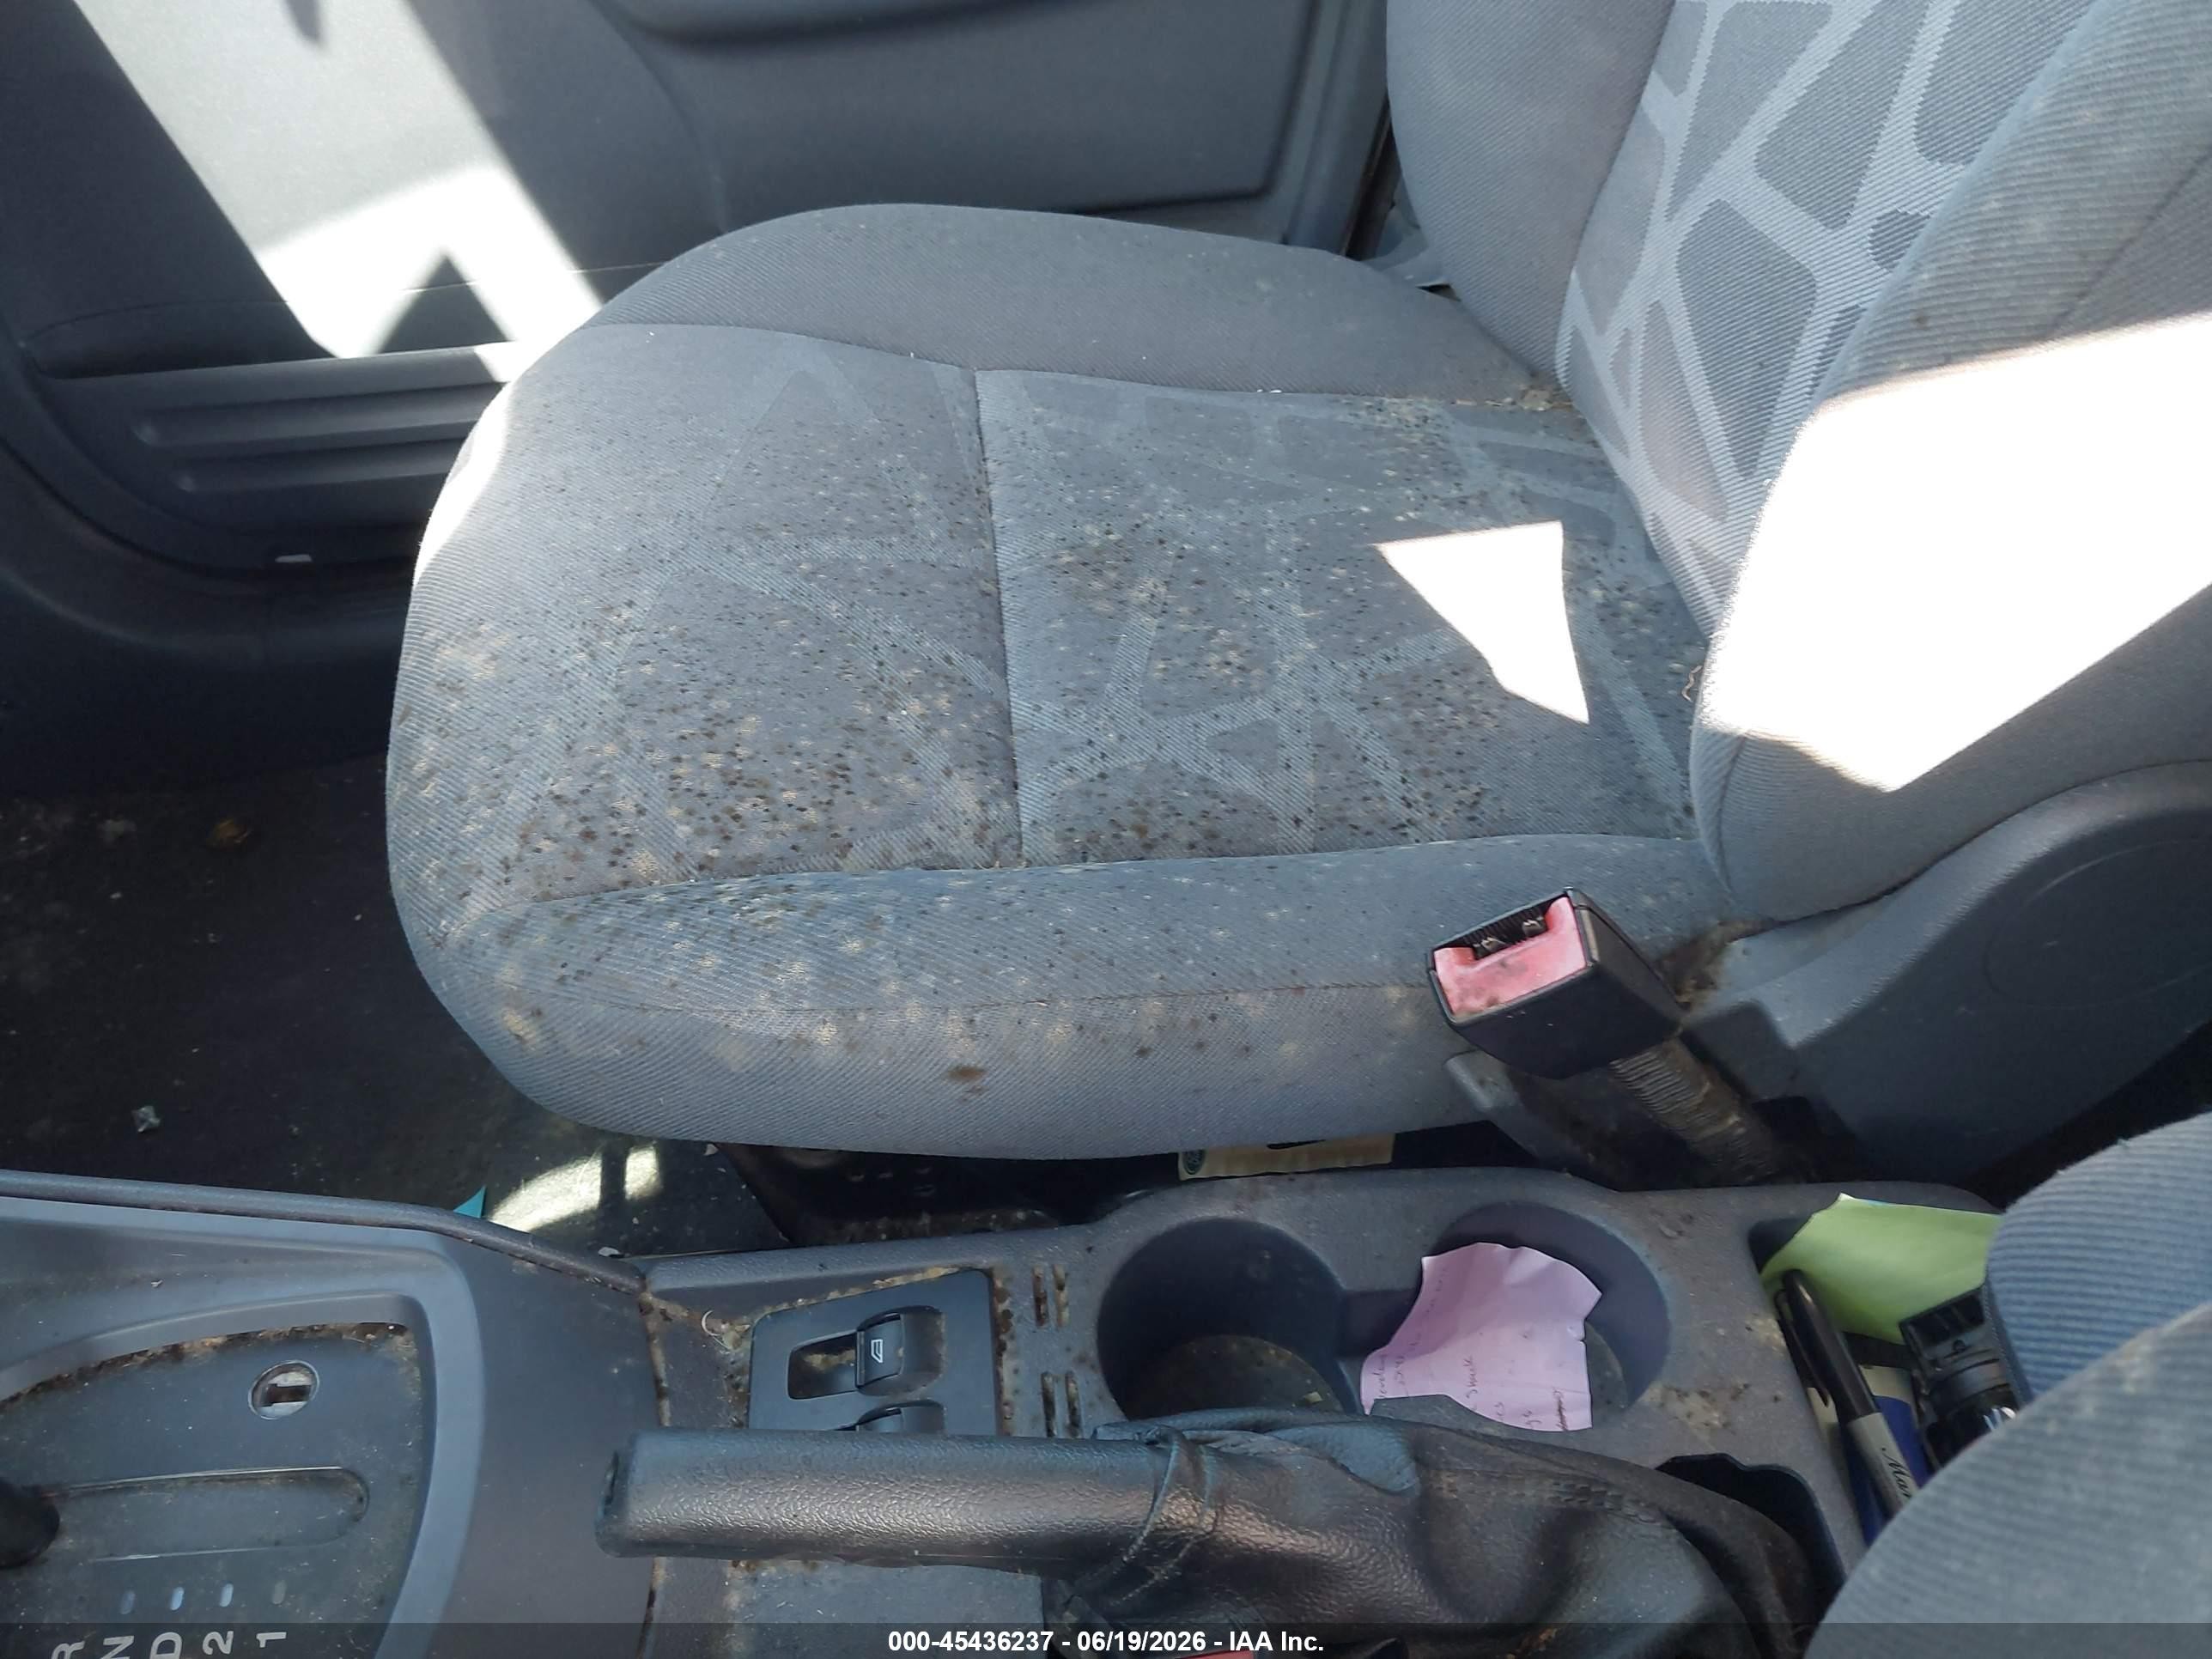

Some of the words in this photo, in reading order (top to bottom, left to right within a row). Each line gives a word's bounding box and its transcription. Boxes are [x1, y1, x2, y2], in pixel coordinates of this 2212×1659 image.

[51, 1640, 85, 1659] R
[100, 1635, 135, 1659] N
[149, 1632, 183, 1659] D
[202, 1631, 234, 1655] 2
[256, 1632, 287, 1648] 1
